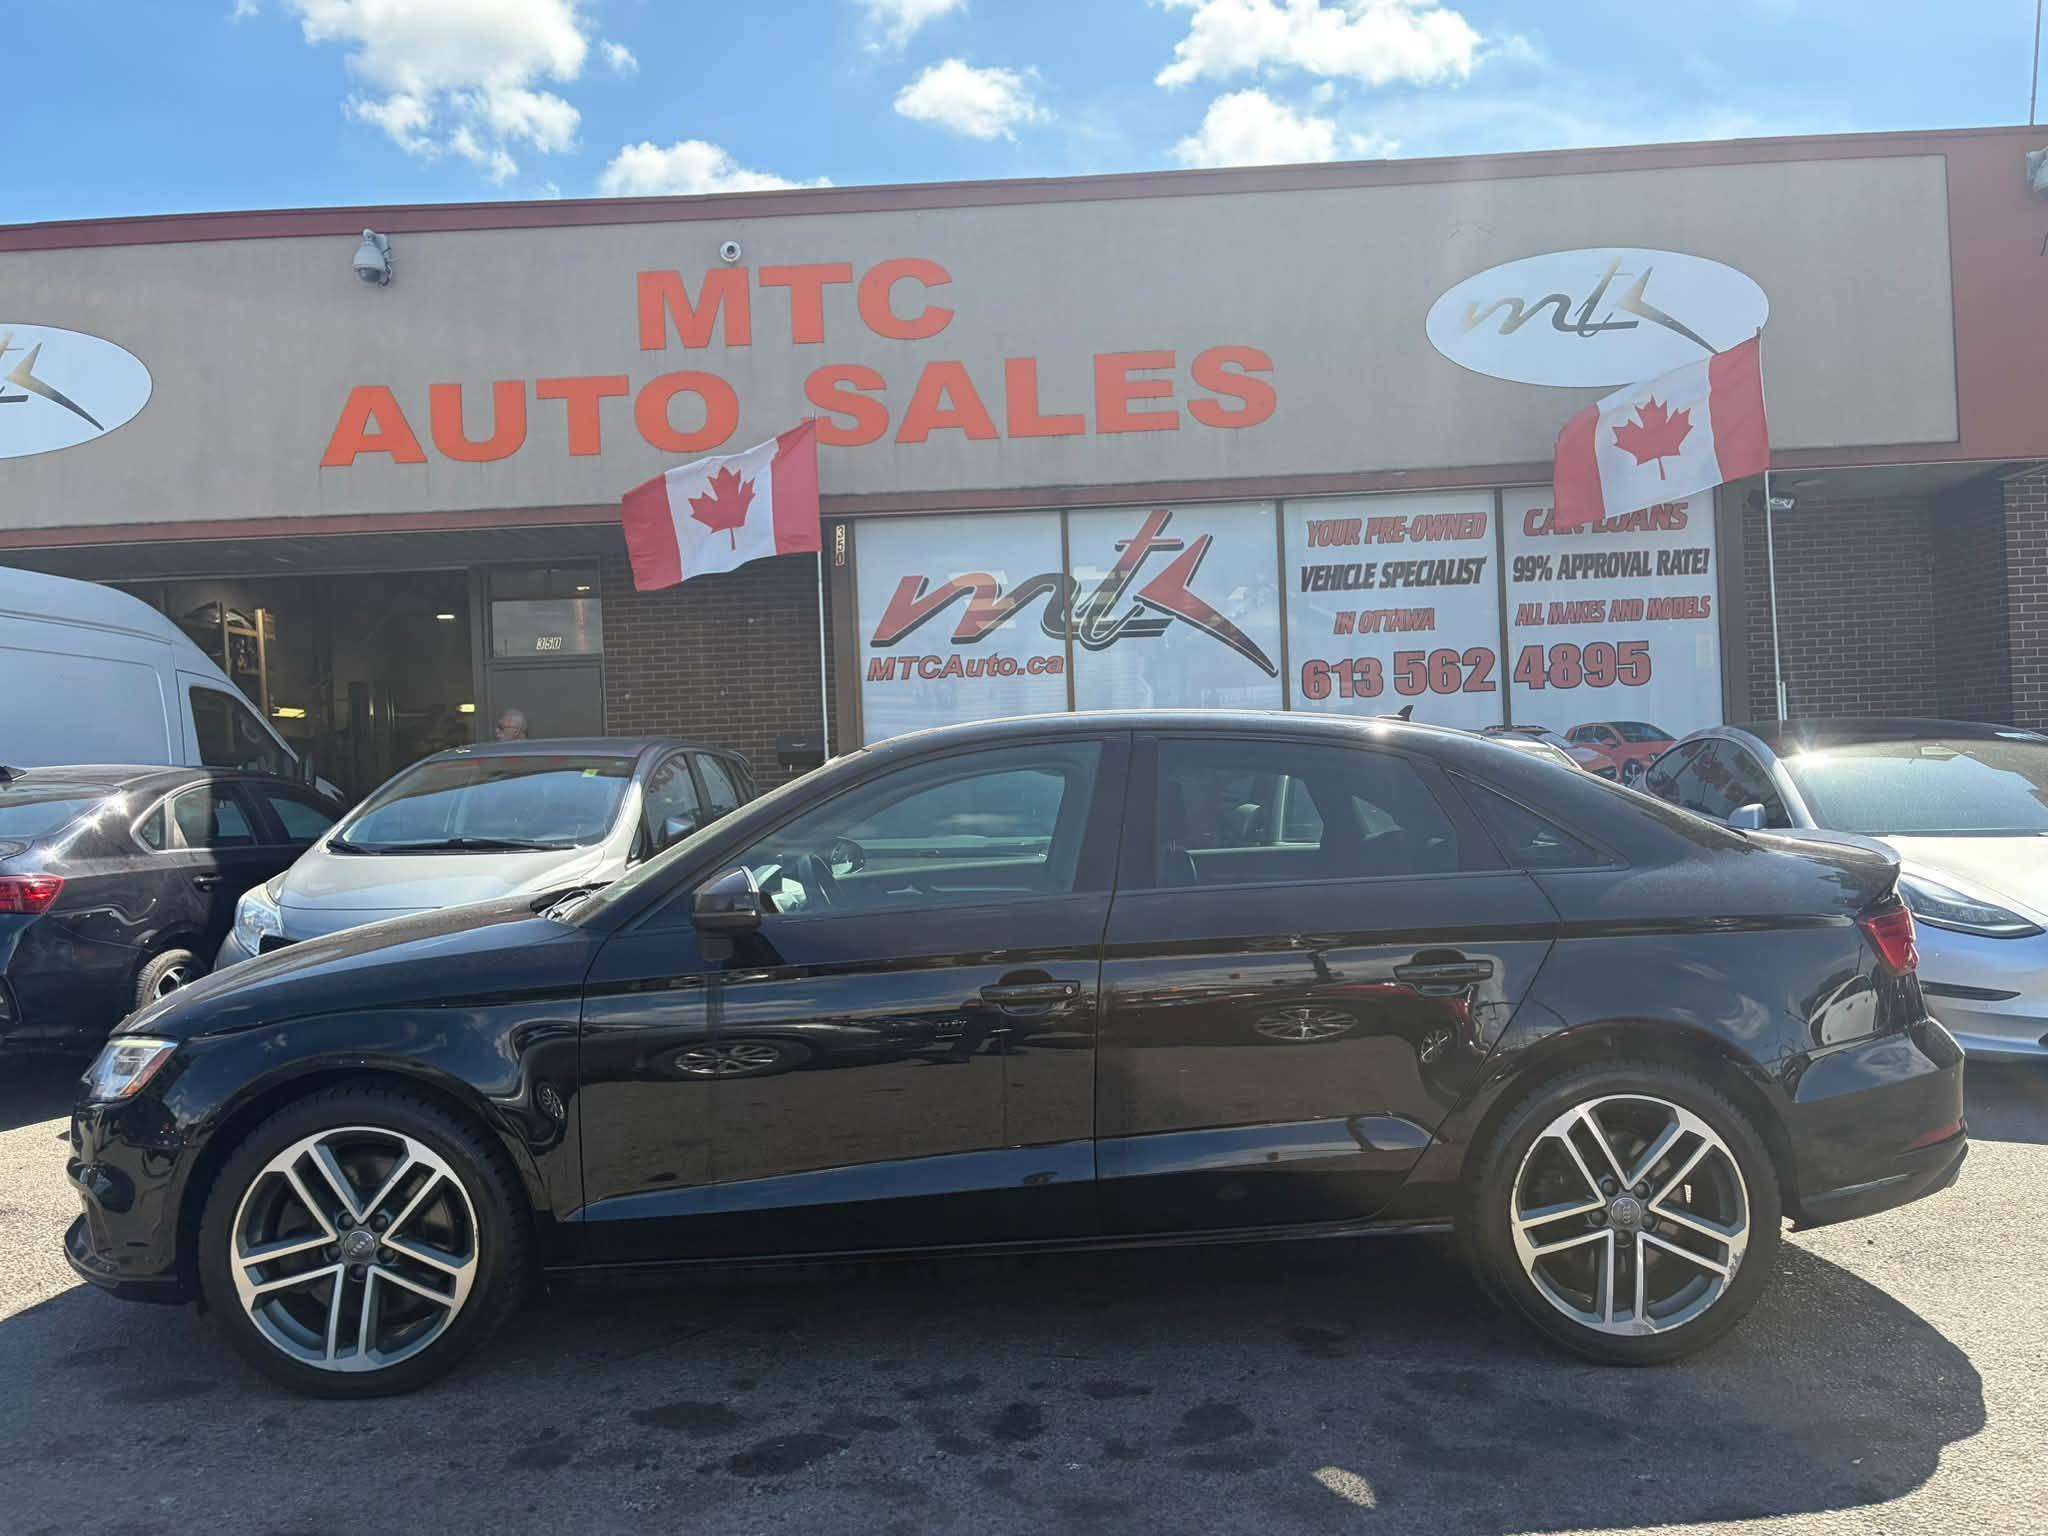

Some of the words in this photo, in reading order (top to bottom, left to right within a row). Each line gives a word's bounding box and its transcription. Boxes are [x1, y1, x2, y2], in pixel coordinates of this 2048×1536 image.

[637, 257, 955, 351] MTC
[803, 345, 1278, 447] SALES
[320, 370, 740, 467] AUTO
[836, 524, 845, 566] 350
[1306, 518, 1363, 548] YOUR
[1364, 511, 1488, 544] PRE-OWNED
[1301, 562, 1377, 593] VEHICLE
[1379, 555, 1488, 588] SPECIALIST
[1513, 554, 1553, 582] 99%
[1556, 550, 1652, 580] APPROVAL
[1656, 547, 1711, 576] RATE!
[1333, 611, 1357, 635] IN
[1358, 607, 1436, 634] OTTAWA
[1514, 602, 1545, 626] ALL
[1548, 600, 1606, 625] MAKES
[1607, 598, 1645, 622] AND
[1647, 595, 1712, 621] MODELS
[867, 652, 1064, 682] MTCAuto.ca
[1302, 656, 1384, 700] 613
[1393, 646, 1497, 696] 562
[1513, 640, 1652, 690] 4895
